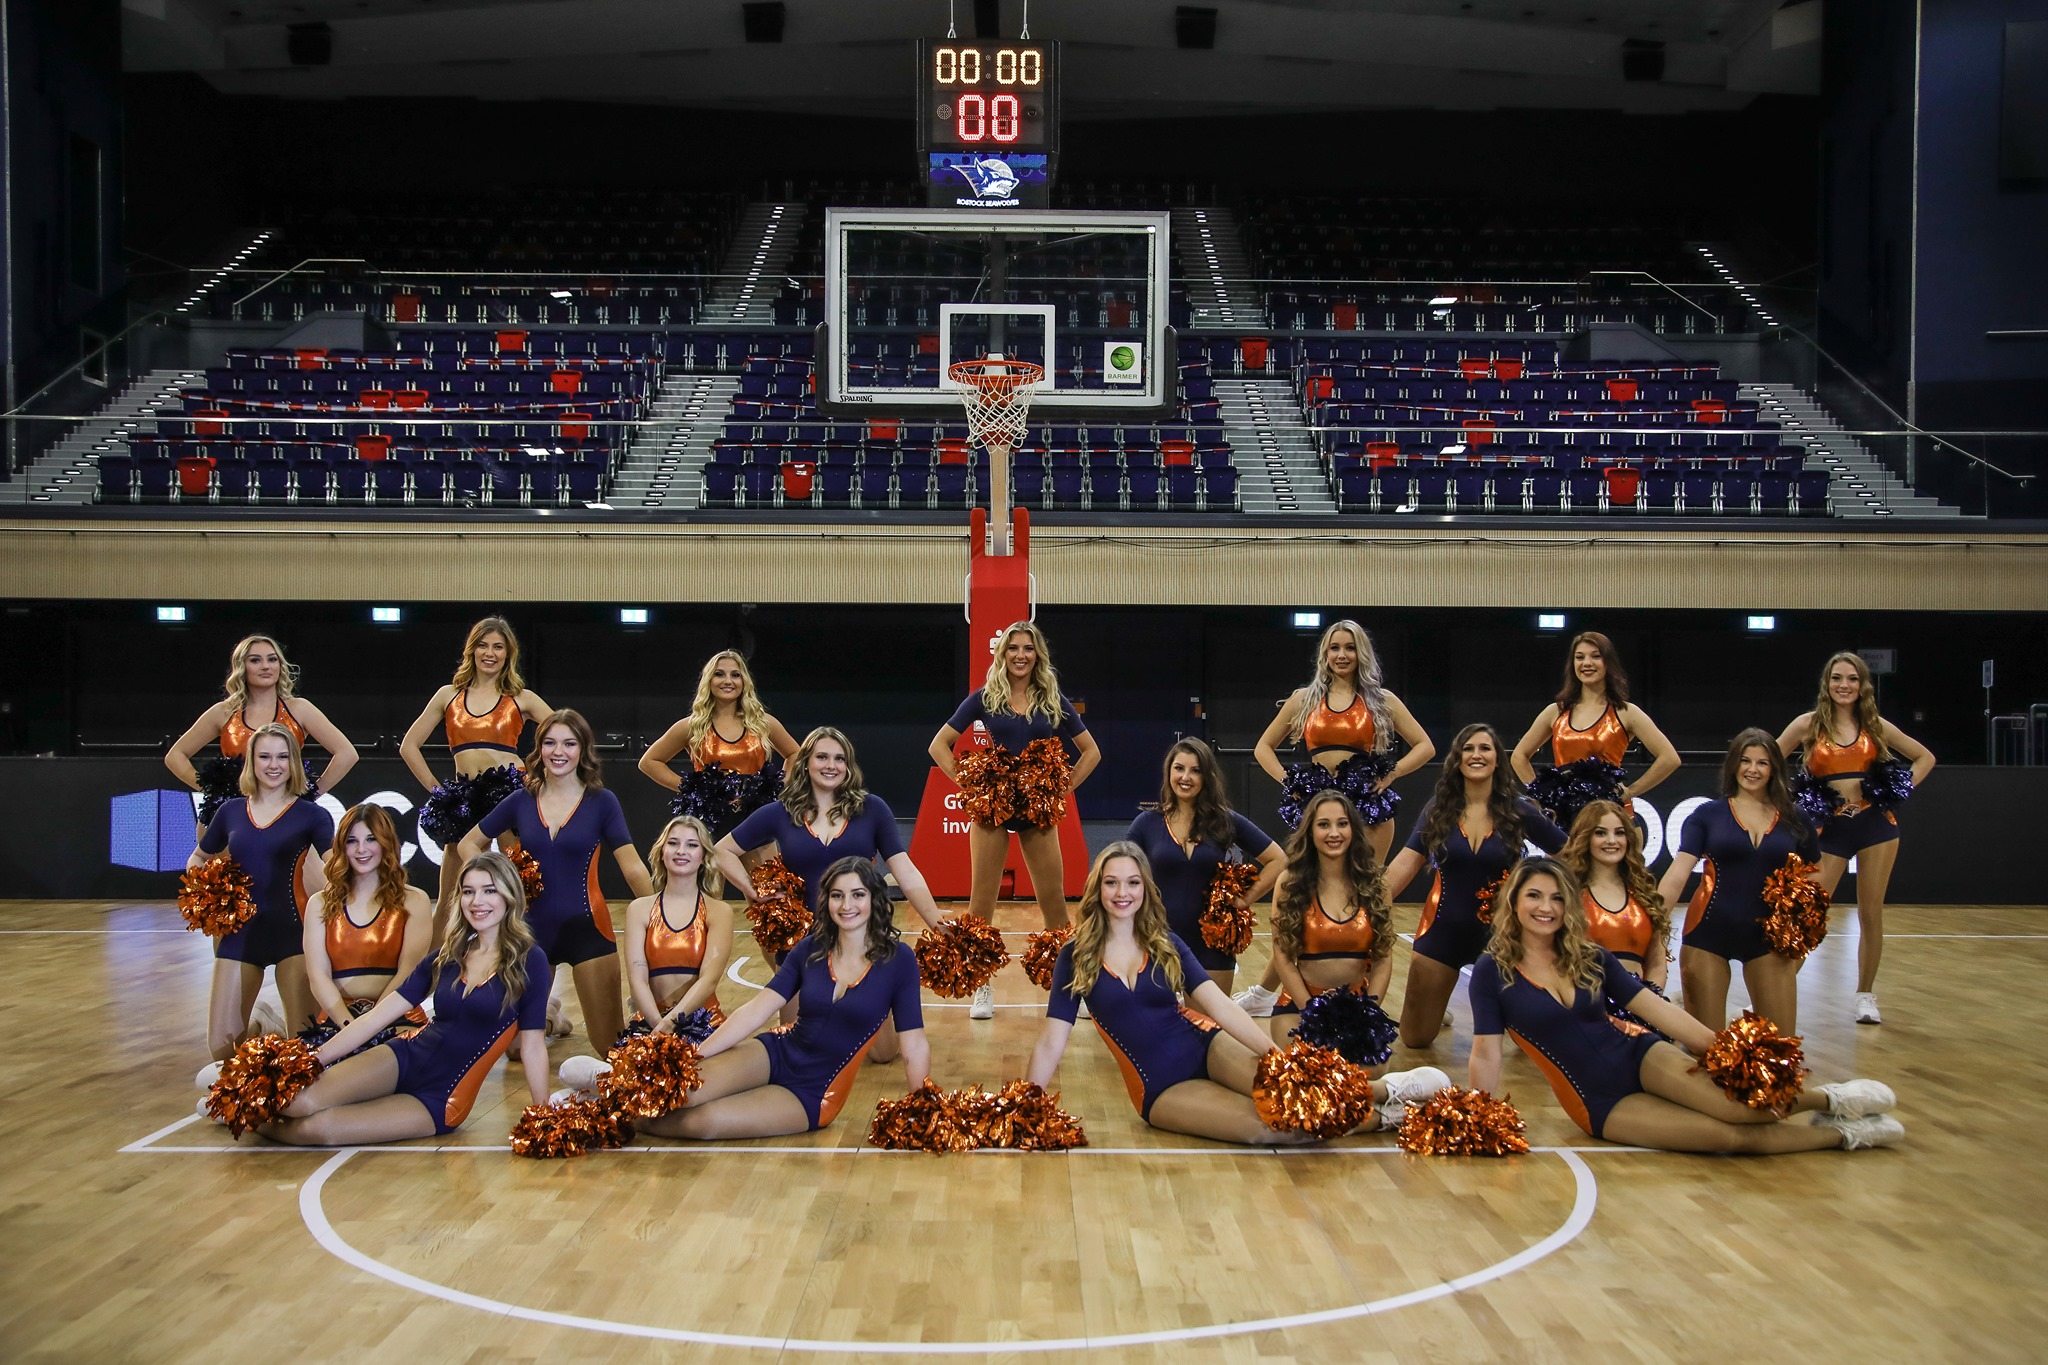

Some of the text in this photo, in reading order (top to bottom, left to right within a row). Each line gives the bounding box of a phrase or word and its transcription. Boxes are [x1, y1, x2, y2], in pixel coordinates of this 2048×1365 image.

[958, 94, 1018, 141] 00
[956, 198, 1020, 207] ROSTOCK SEAWOLVES
[973, 736, 989, 745] Ve
[942, 817, 971, 834] inv
